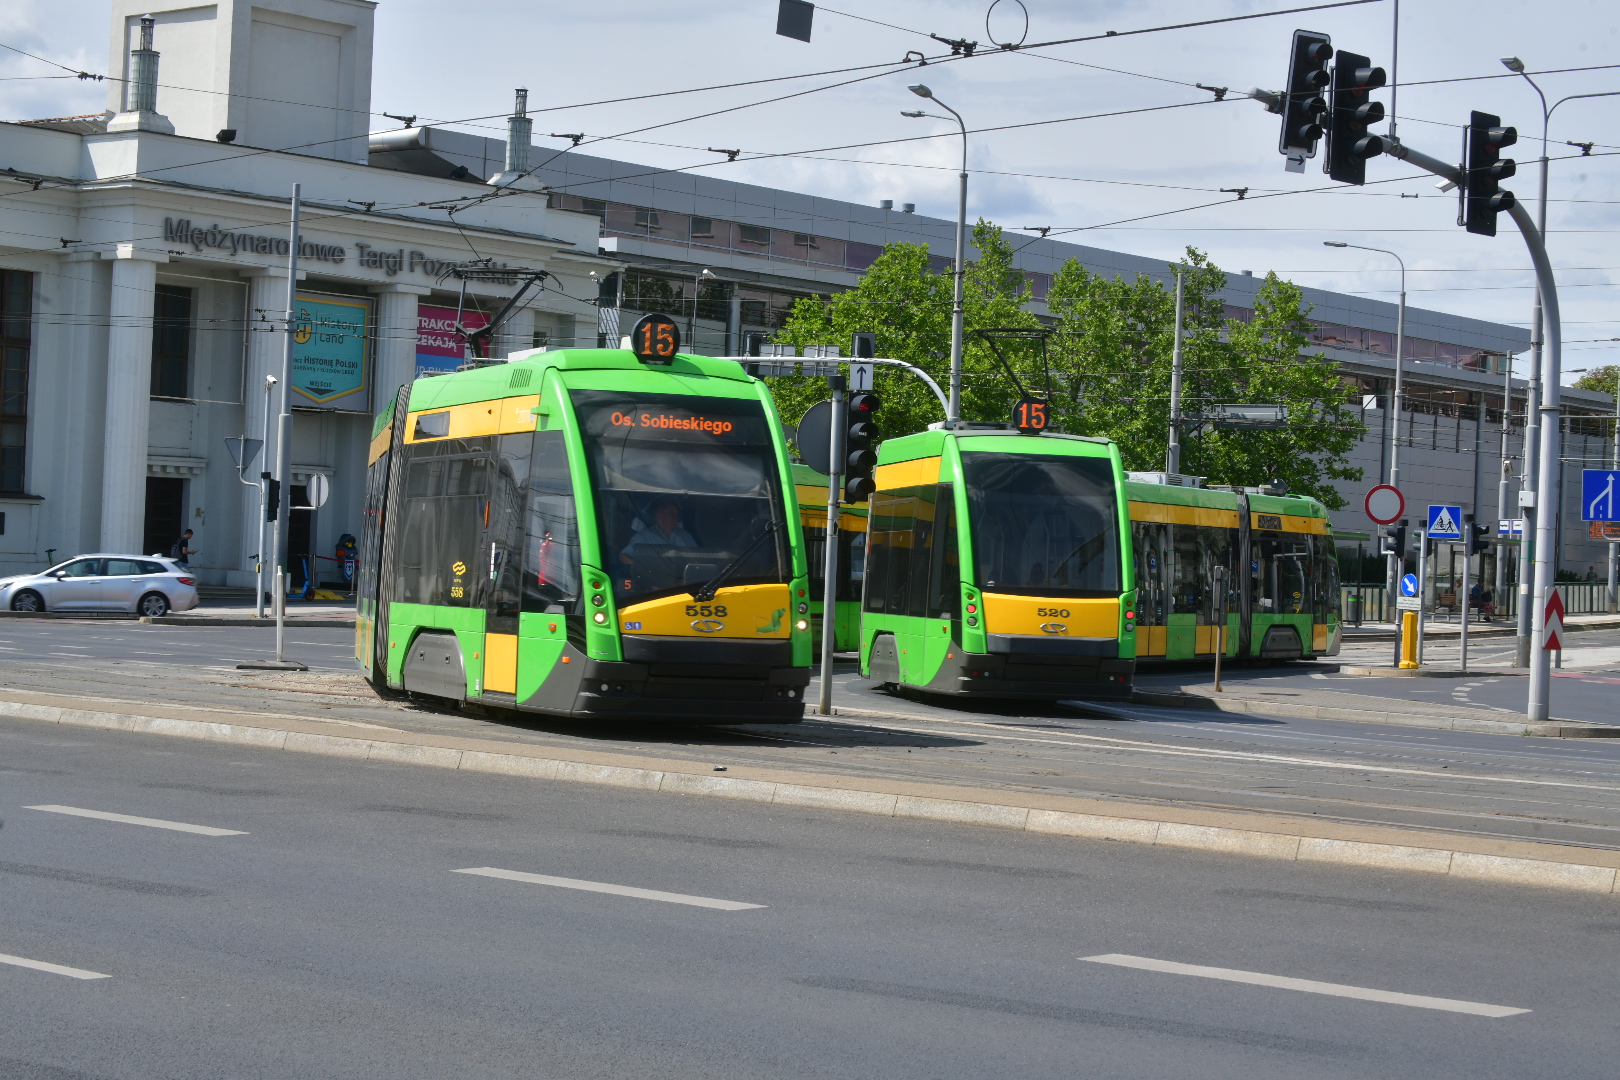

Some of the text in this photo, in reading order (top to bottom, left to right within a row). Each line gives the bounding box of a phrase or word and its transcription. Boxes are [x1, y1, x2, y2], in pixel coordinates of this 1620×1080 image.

[355, 242, 404, 276] Targi
[320, 317, 358, 334] History
[319, 333, 344, 345] Land
[641, 322, 675, 356] 15
[335, 358, 358, 369] POLSKI
[1018, 402, 1046, 429] 15
[611, 412, 732, 434] Os. Sobieskiego
[624, 580, 632, 590] 5
[451, 586, 464, 598] 558
[685, 605, 728, 617] 558
[1037, 607, 1071, 618] 520
